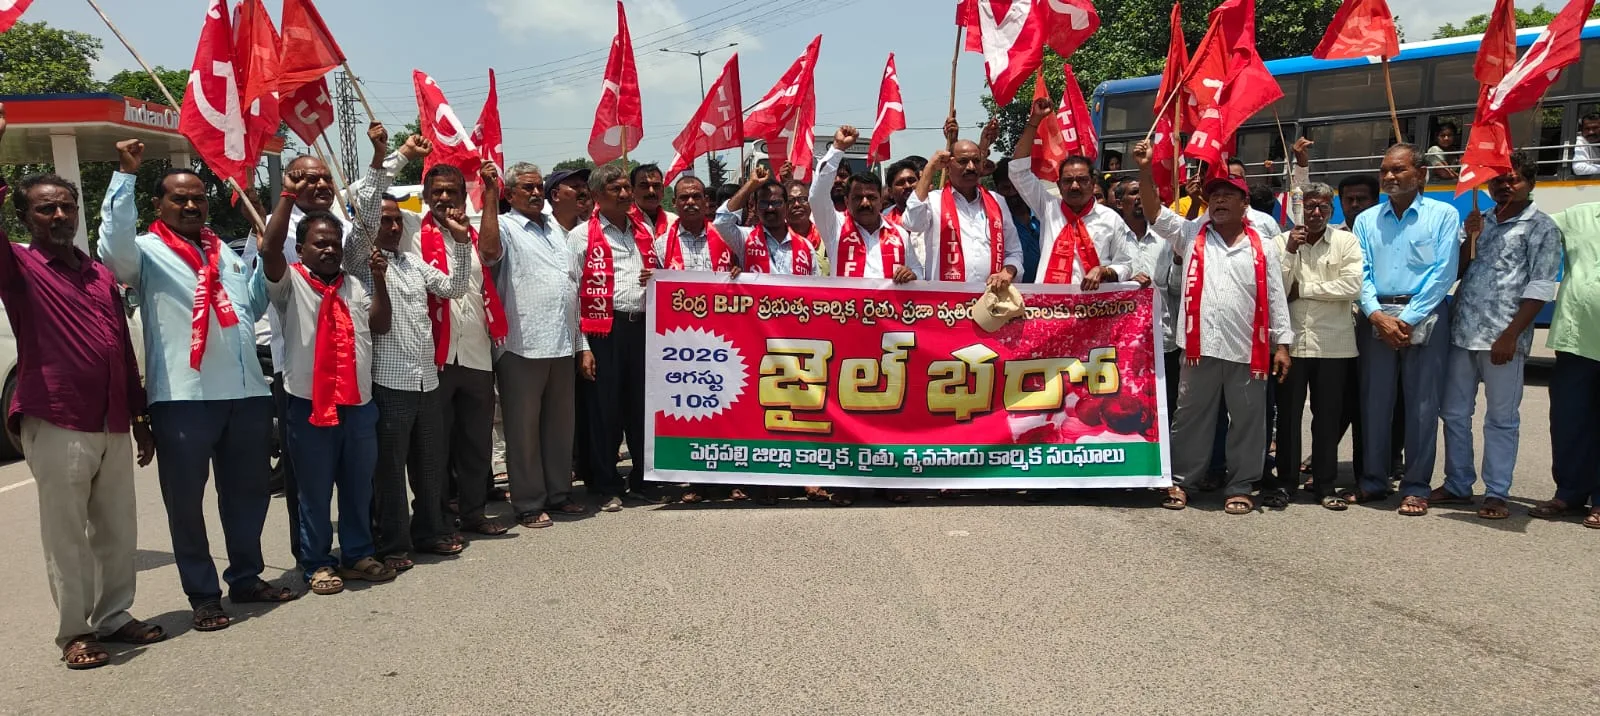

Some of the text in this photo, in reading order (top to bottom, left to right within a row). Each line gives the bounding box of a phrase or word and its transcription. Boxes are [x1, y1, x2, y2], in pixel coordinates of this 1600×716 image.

[586, 287, 608, 296] CITU
[588, 312, 609, 320] CITU
[671, 288, 708, 318] కేంద్ర
[714, 294, 754, 313] BJP
[757, 296, 811, 323] ప్రభుత్వ
[812, 299, 859, 324] కార్మిక,
[862, 299, 899, 325] రైతు,
[901, 300, 933, 323] ప్రజా
[937, 297, 977, 327] వ్యతిరే
[662, 347, 729, 363] 2026
[665, 369, 724, 392] ఆగస్టు
[758, 331, 1121, 434] జైల్ భరో
[670, 393, 720, 408] 10న
[689, 443, 1125, 473] పెద్దపల్లి జిల్లా కార్మిక, రైతు, వ్యవసాయ కార్మిక సంఘాలు
